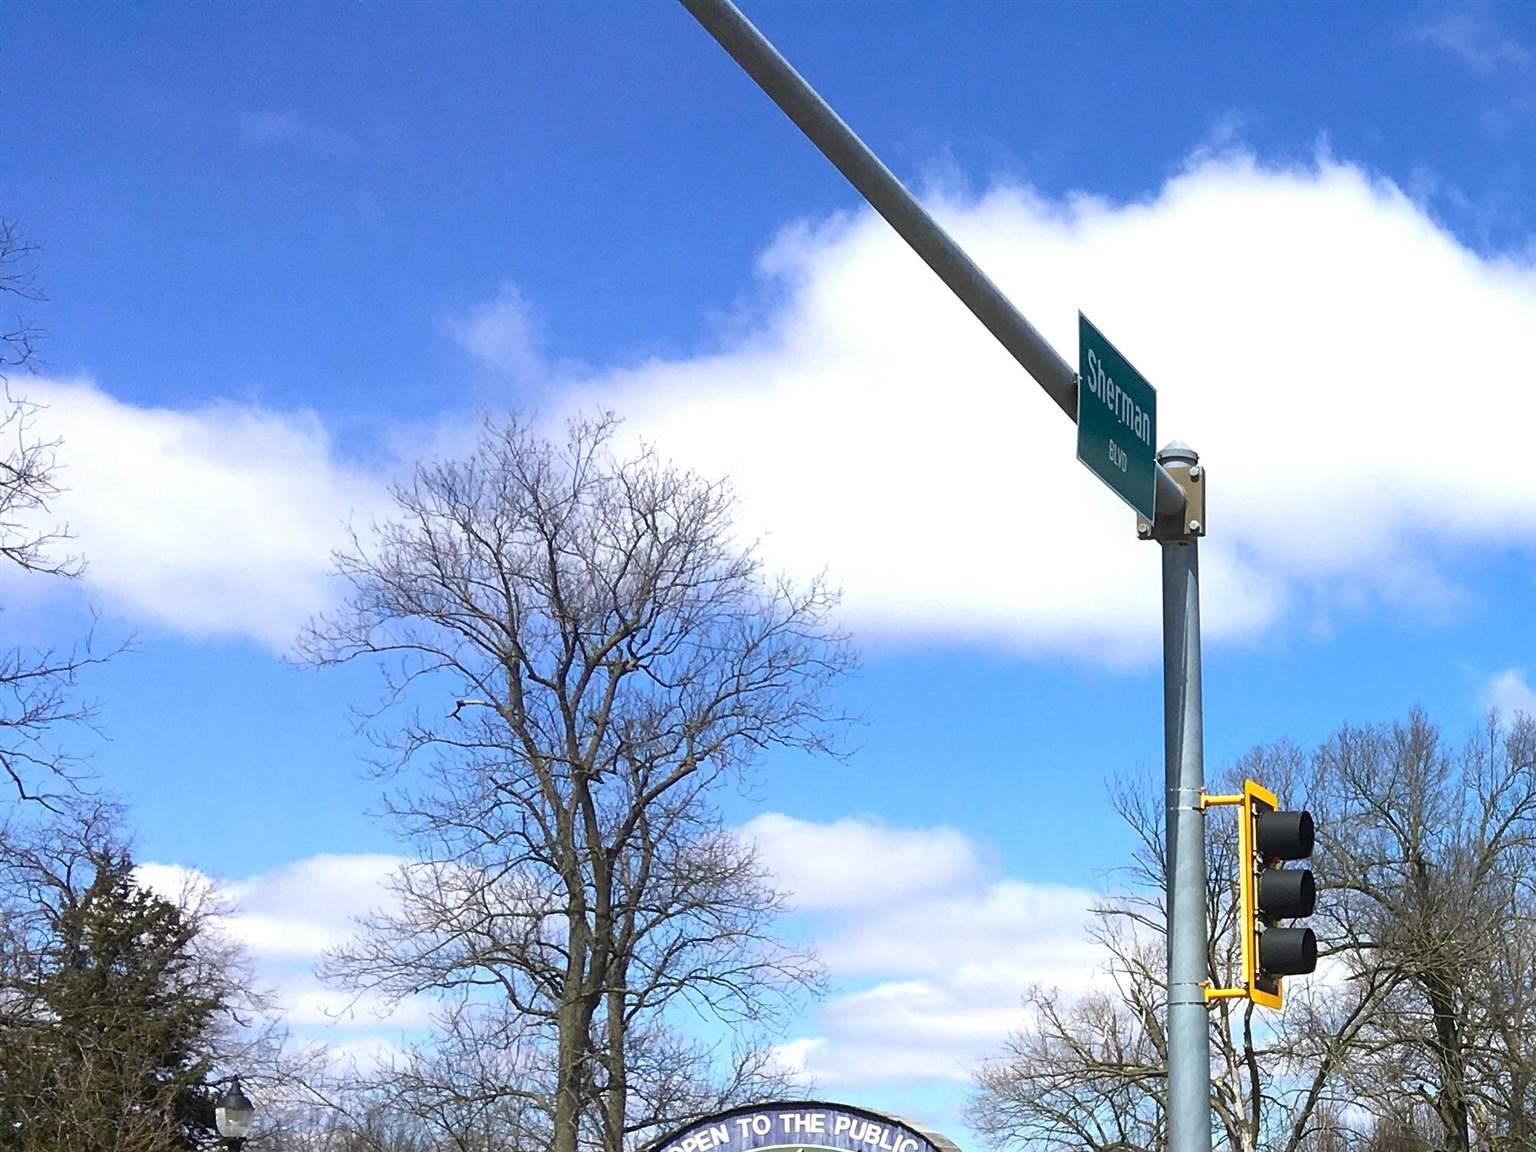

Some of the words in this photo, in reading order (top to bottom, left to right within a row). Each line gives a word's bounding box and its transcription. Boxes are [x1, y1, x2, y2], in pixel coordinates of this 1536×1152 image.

[1087, 348, 1151, 447] Sherman
[1108, 438, 1128, 473] BLVD
[736, 1115, 771, 1138] TO
[779, 1113, 826, 1134] THE
